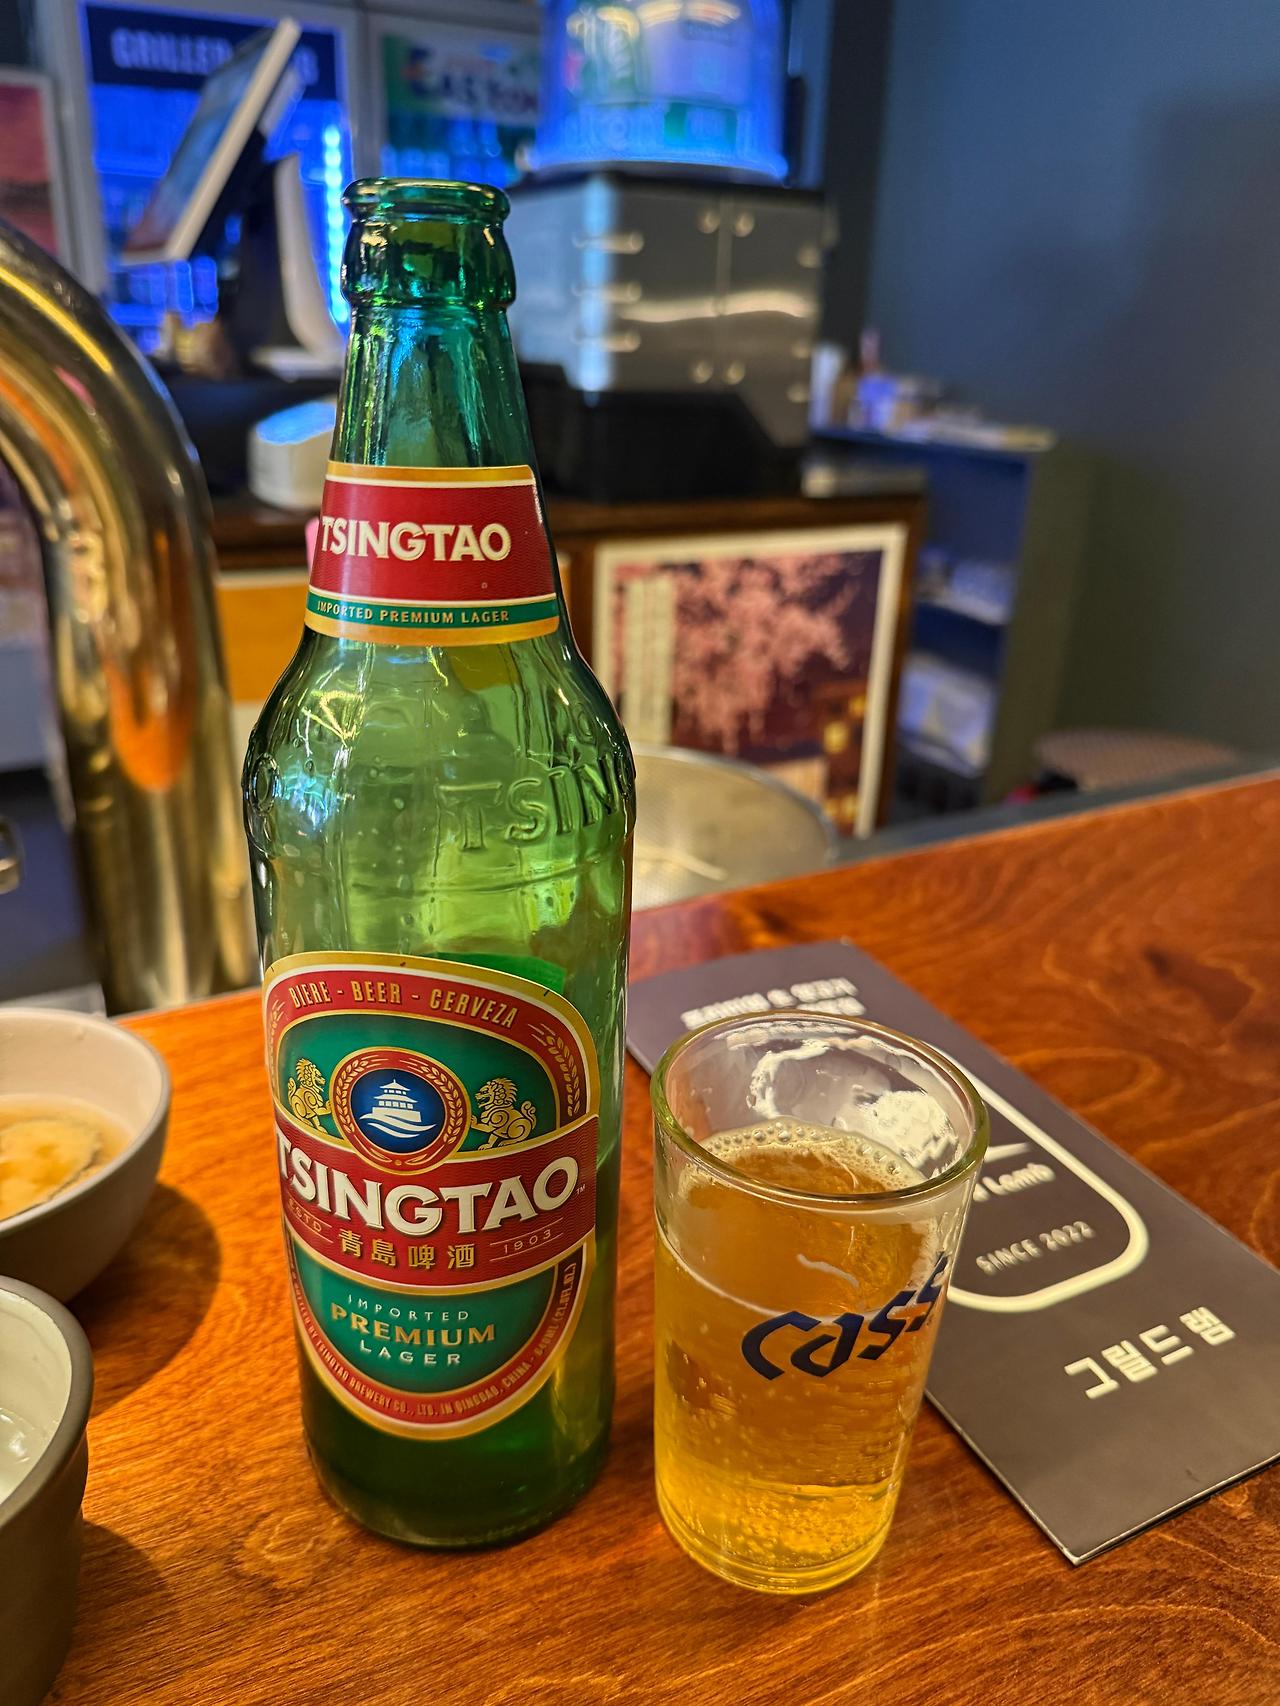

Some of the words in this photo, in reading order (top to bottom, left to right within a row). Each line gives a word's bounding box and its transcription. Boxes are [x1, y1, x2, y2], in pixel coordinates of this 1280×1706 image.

[321, 515, 512, 562] TSINGTAO
[317, 600, 373, 620] IMPORTED
[379, 610, 454, 624] PREMIUM
[461, 610, 509, 623] LAGER
[288, 980, 332, 1009] BIERE
[350, 980, 403, 1004] BEER
[275, 1122, 579, 1236] TSINGTAO
[338, 1227, 476, 1270] 青島啤酒
[503, 1229, 552, 1254] 1903
[976, 1239, 1043, 1276] SINCE
[330, 1301, 497, 1348] PREMIUM
[348, 1292, 470, 1322] IMPORTED
[360, 1339, 461, 1366] LAGER
[350, 1376, 392, 1410] BREWERY
[502, 1361, 532, 1388] CHINA
